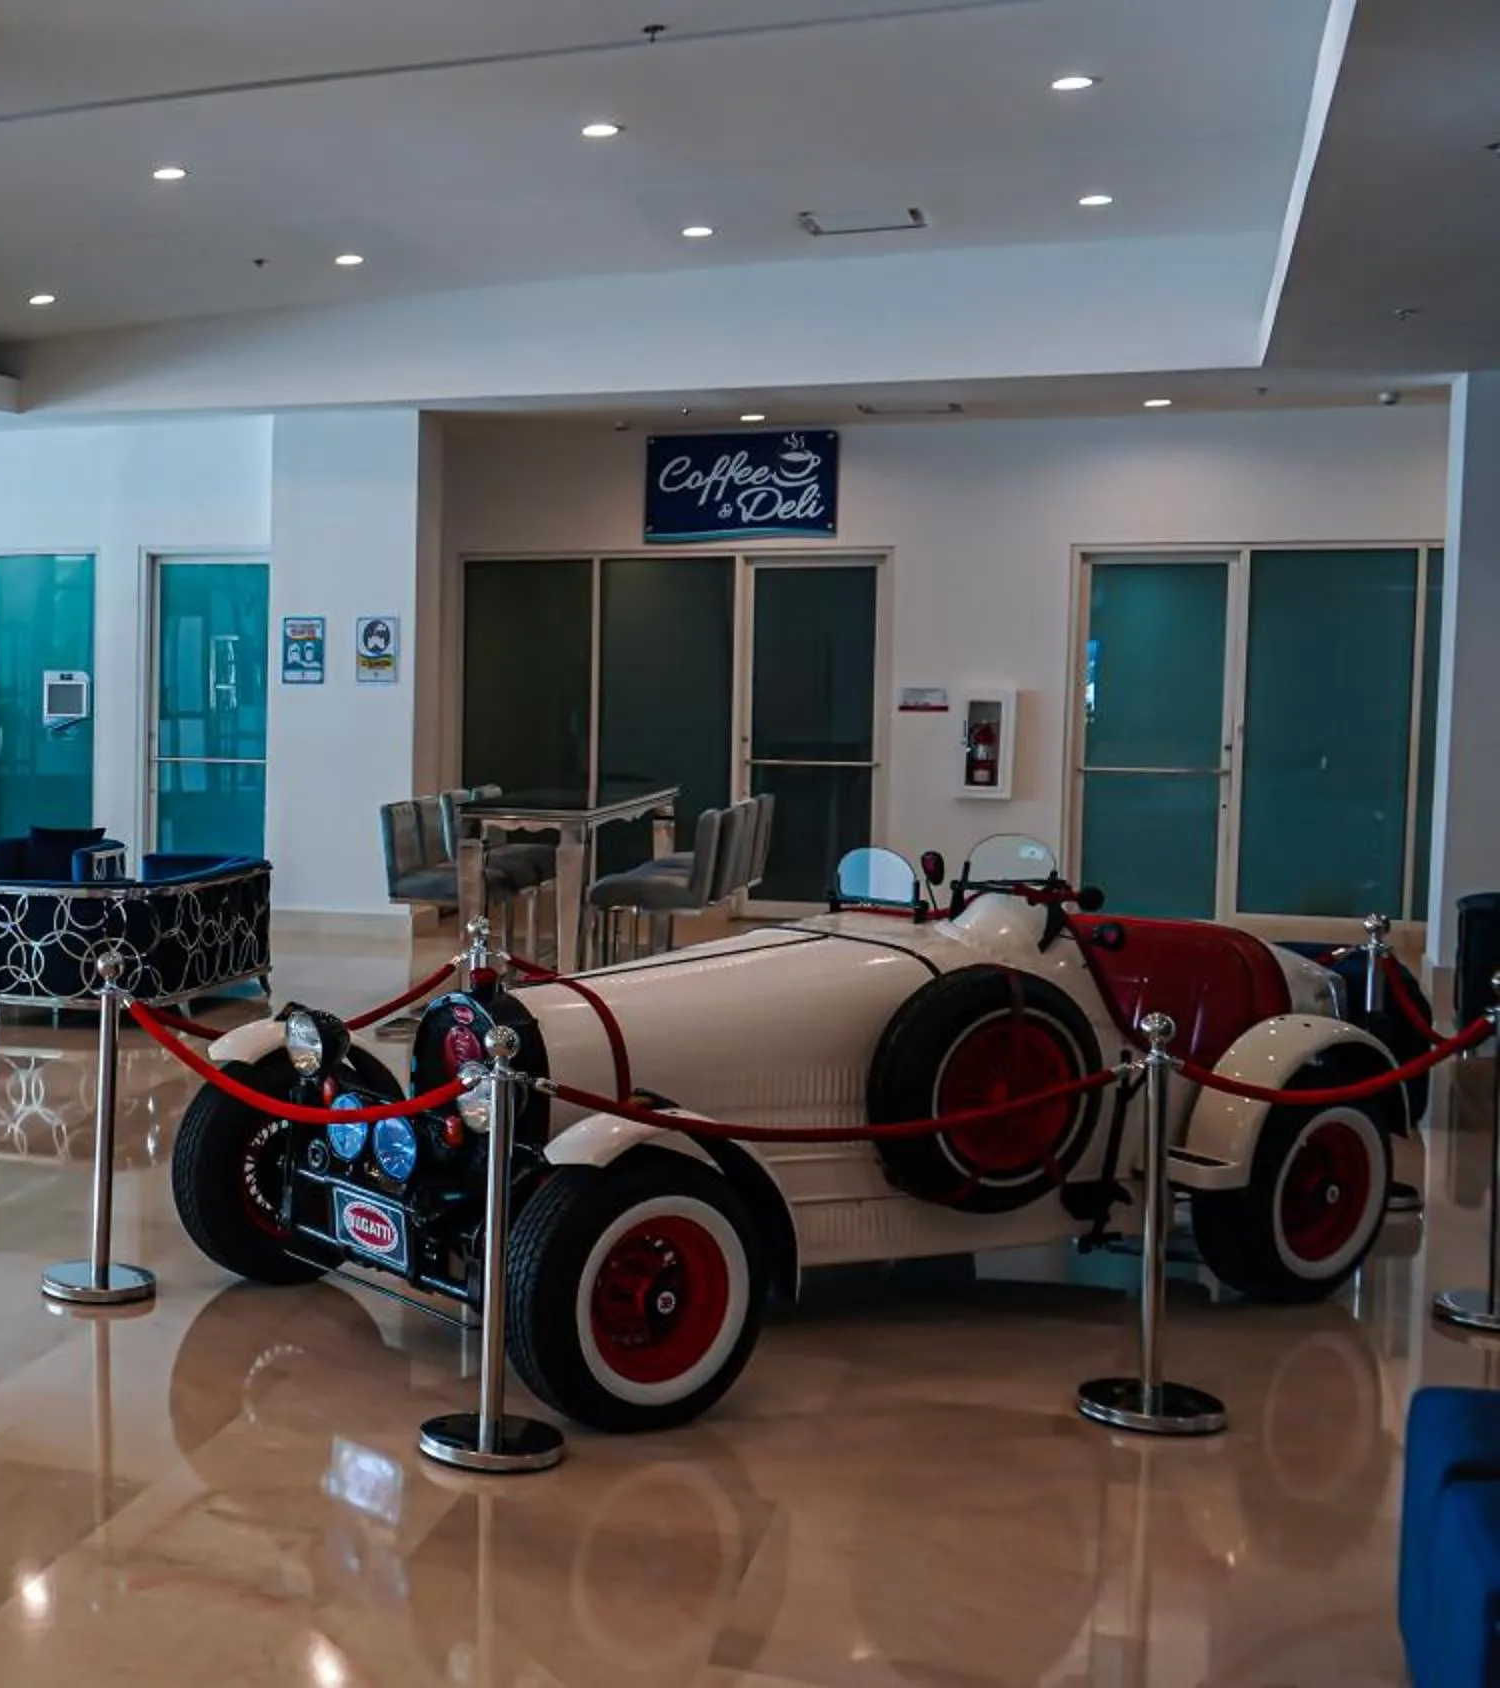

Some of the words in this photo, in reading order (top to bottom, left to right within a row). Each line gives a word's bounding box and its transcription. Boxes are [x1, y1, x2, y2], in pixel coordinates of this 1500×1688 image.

[658, 450, 773, 506] Coffee
[717, 503, 733, 519] &
[736, 484, 825, 523] Deli
